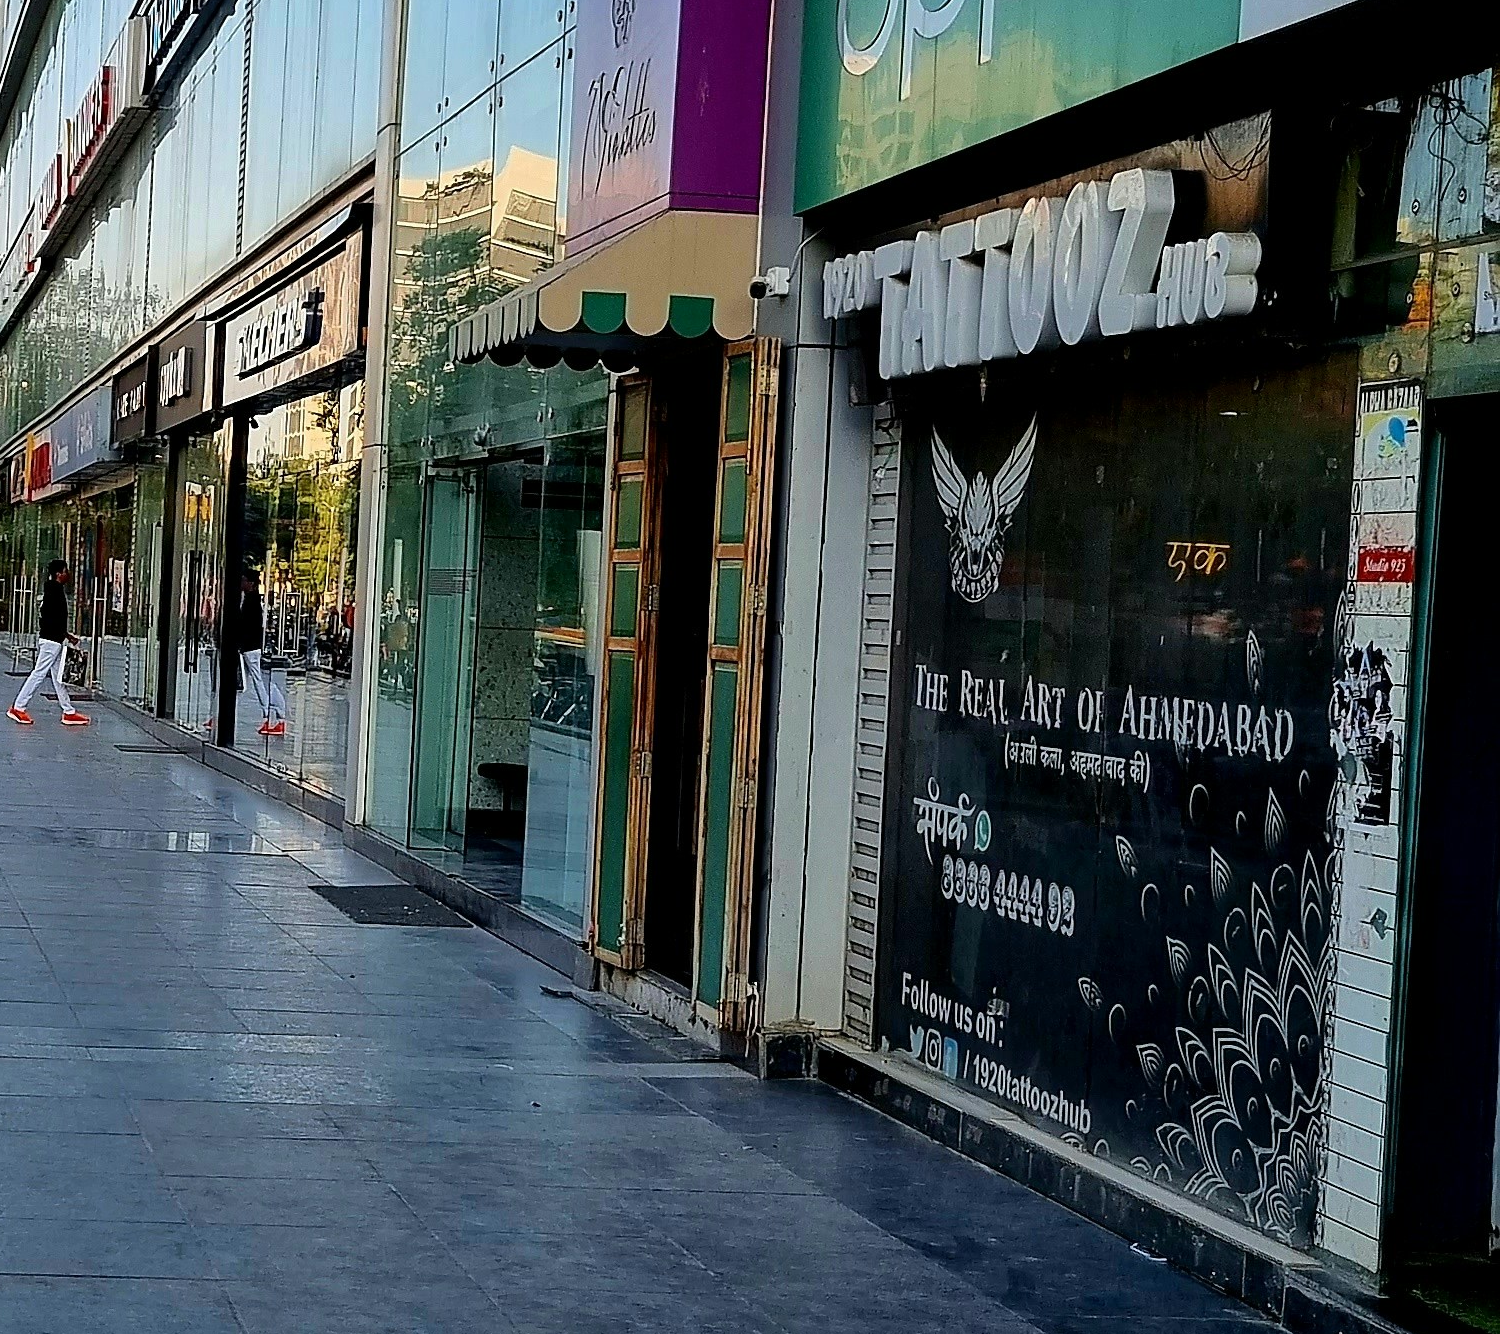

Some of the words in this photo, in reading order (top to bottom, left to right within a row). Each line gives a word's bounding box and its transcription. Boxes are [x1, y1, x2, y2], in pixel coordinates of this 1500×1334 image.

[823, 251, 876, 320] 1920
[874, 168, 1175, 380] TATTOOZ
[1156, 232, 1258, 329] HUB
[901, 971, 952, 1025] Follow
[954, 1001, 974, 1034] us
